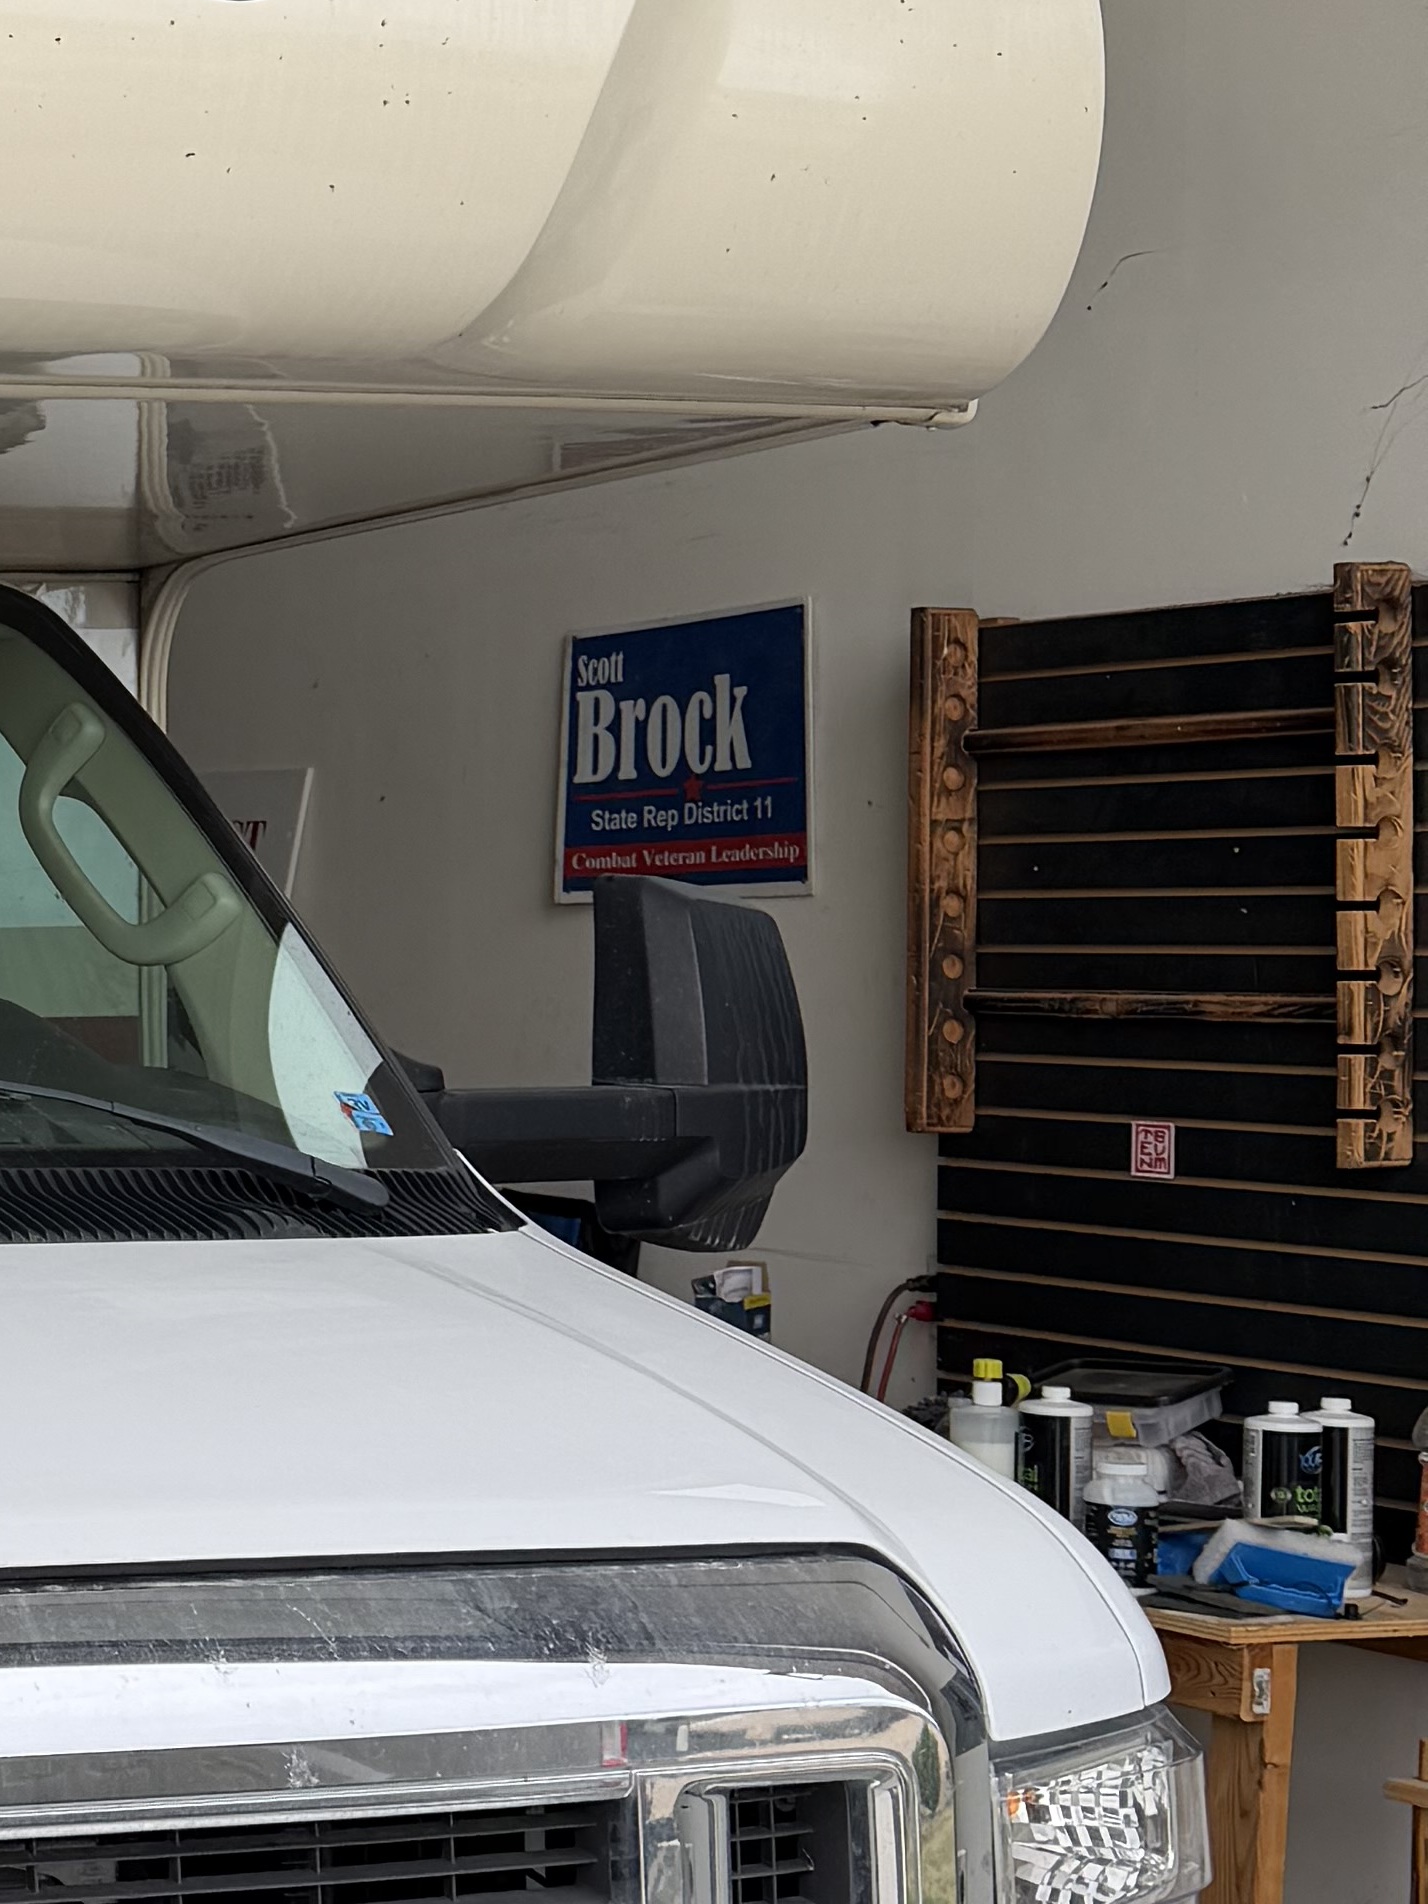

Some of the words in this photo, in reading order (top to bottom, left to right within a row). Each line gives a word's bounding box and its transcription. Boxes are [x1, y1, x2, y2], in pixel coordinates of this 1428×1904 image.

[577, 651, 625, 687] Scott
[572, 673, 753, 784] Brock
[591, 808, 638, 831] State
[644, 805, 679, 832] Rep
[684, 799, 749, 825] District
[754, 796, 773, 820] 11
[571, 851, 638, 870] Combat
[643, 846, 706, 867] Veteran
[711, 840, 800, 864] Leadership
